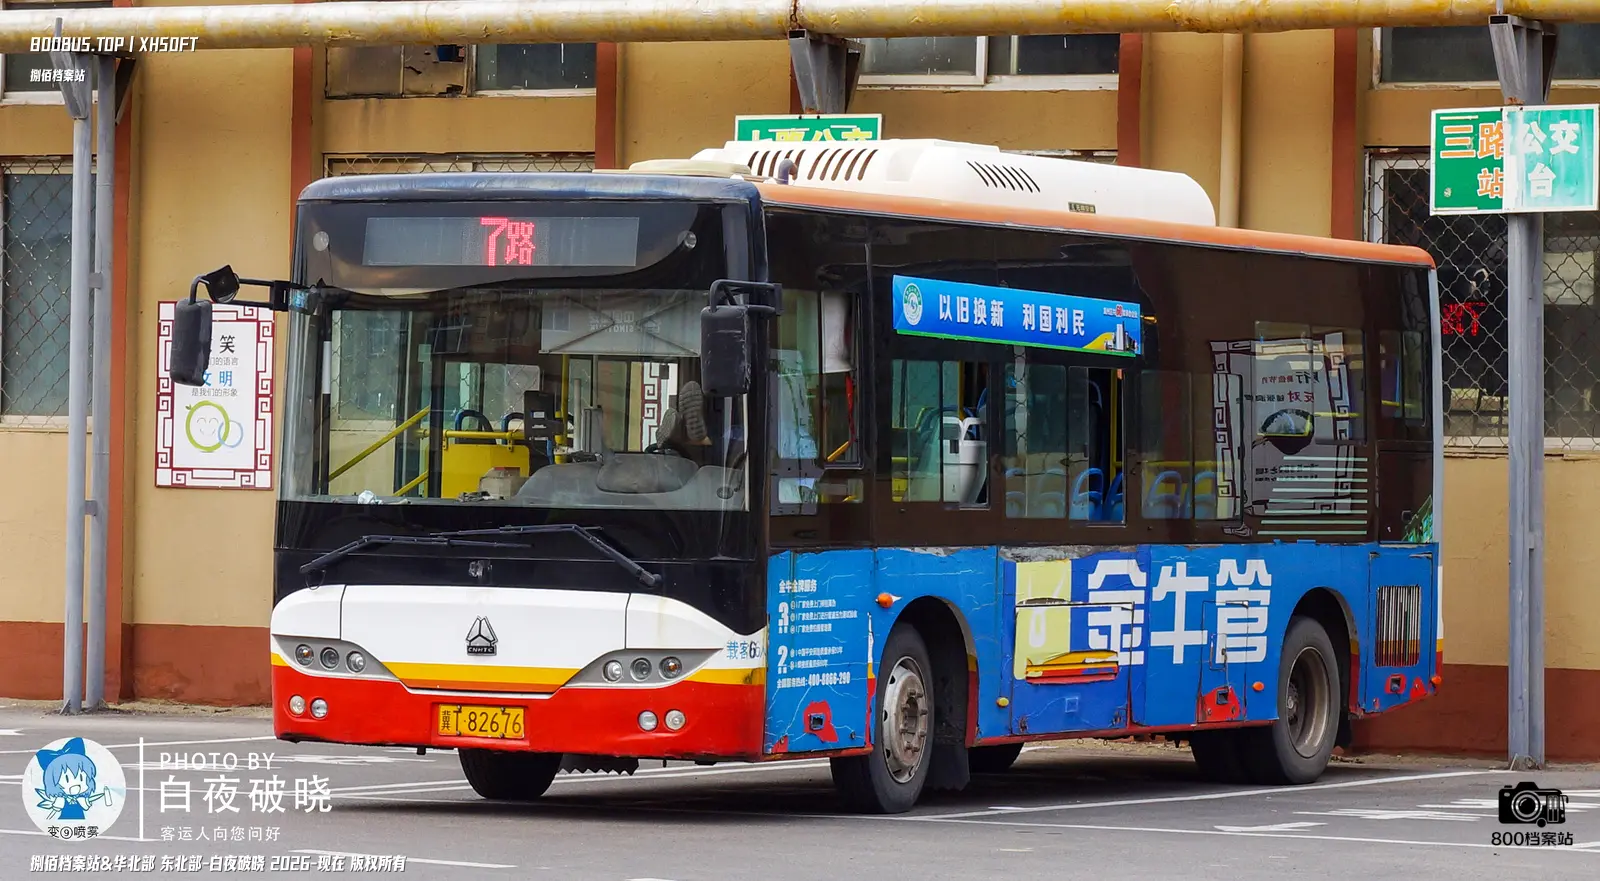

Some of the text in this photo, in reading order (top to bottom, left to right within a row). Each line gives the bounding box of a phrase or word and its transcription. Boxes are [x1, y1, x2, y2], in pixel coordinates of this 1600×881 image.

[480, 216, 536, 267] 7路
[938, 294, 1004, 327] 以旧换新
[1022, 303, 1085, 336] 利国利民
[191, 388, 238, 397] 是我们的形象
[1088, 559, 1272, 666] 金牛管
